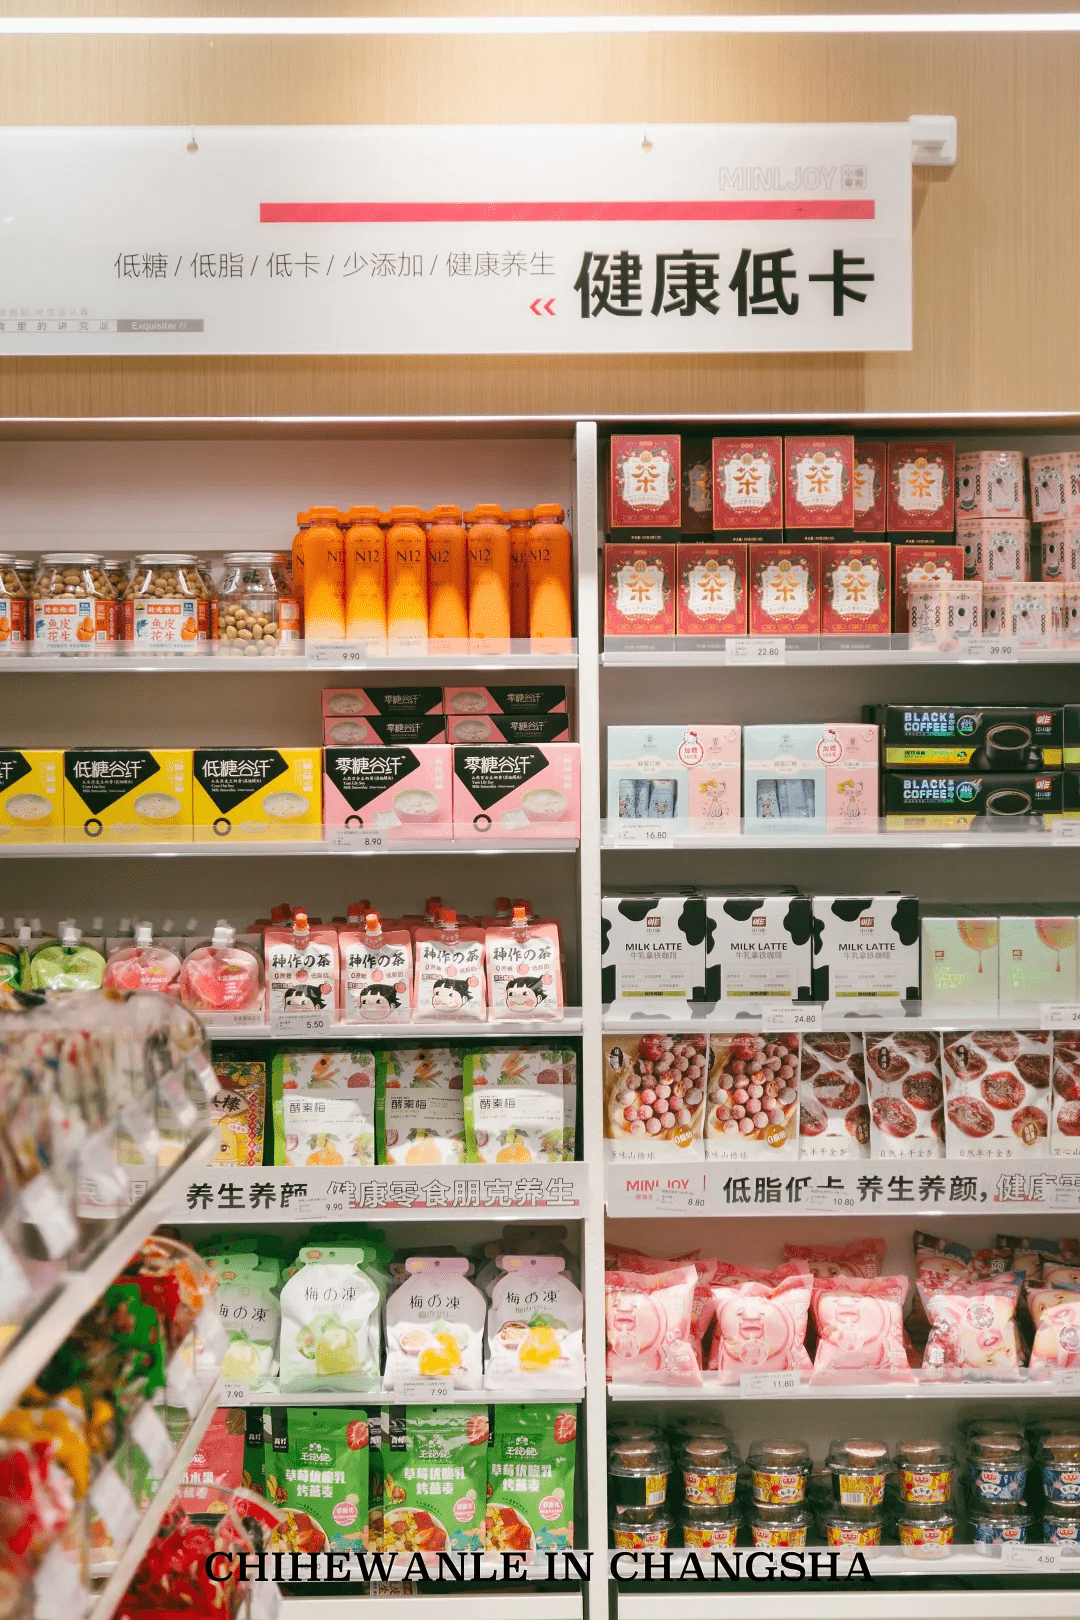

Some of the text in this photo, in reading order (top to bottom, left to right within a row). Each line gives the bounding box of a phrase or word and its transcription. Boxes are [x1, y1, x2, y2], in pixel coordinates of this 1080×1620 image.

[114, 253, 168, 278] 低糖
[190, 253, 243, 278] 低脂
[266, 252, 321, 278] 低卡
[343, 252, 423, 277] 少添加
[446, 251, 556, 277] 健康养生
[573, 247, 875, 319] 健康低卡
[132, 321, 176, 331] Exquisiter
[328, 550, 346, 562] N1
[356, 550, 380, 562] N12
[397, 550, 421, 562] N12
[47, 618, 72, 630] 鱼皮
[150, 618, 175, 630] 鱼皮
[47, 631, 72, 642] 花生
[150, 631, 175, 642] 花生
[757, 648, 779, 656] 22.80
[904, 712, 947, 722] BLACK
[904, 722, 947, 732] COFFEE
[73, 761, 142, 778] 低糖谷纤
[202, 760, 271, 777] 低糖谷纤
[335, 757, 402, 775] 零糖谷纤
[464, 756, 531, 774] 零糖谷纤
[904, 780, 947, 789] BLACK
[904, 790, 947, 799] COFFEE
[646, 831, 667, 839] 16.80
[365, 838, 382, 846] 8.90
[625, 943, 682, 951] MILK LATTE
[730, 943, 788, 951] MILK LATTE
[838, 943, 897, 951] MILK LATTE
[424, 947, 480, 964] 神作の茶
[493, 946, 552, 961] 神作の茶
[630, 951, 677, 960] 牛乳拿铁咖啡
[735, 951, 783, 960] 牛乳拿铁咖啡
[843, 951, 891, 960] 牛乳拿铁咖啡
[272, 953, 334, 969] 神作の茶
[349, 953, 406, 969] 神作の茶
[307, 1020, 324, 1028] 5.50
[794, 1015, 816, 1023] 24.80
[289, 1101, 326, 1113] 酵素梅
[391, 1096, 428, 1110] 酵素梅
[479, 1097, 516, 1110] 酵素梅
[611, 1150, 655, 1160] 原味山楂球
[187, 1177, 576, 1210] 养生养颜 健康零食朋克养生
[687, 1198, 705, 1206] 8.80
[834, 1197, 855, 1206] 10.80
[326, 1203, 343, 1212] 9.90
[305, 1287, 357, 1302] 梅の凍
[506, 1290, 558, 1304] 梅の凍
[410, 1294, 461, 1310] 梅の凍
[773, 1380, 794, 1388] 11.80
[1038, 1555, 1055, 1564] 4.50
